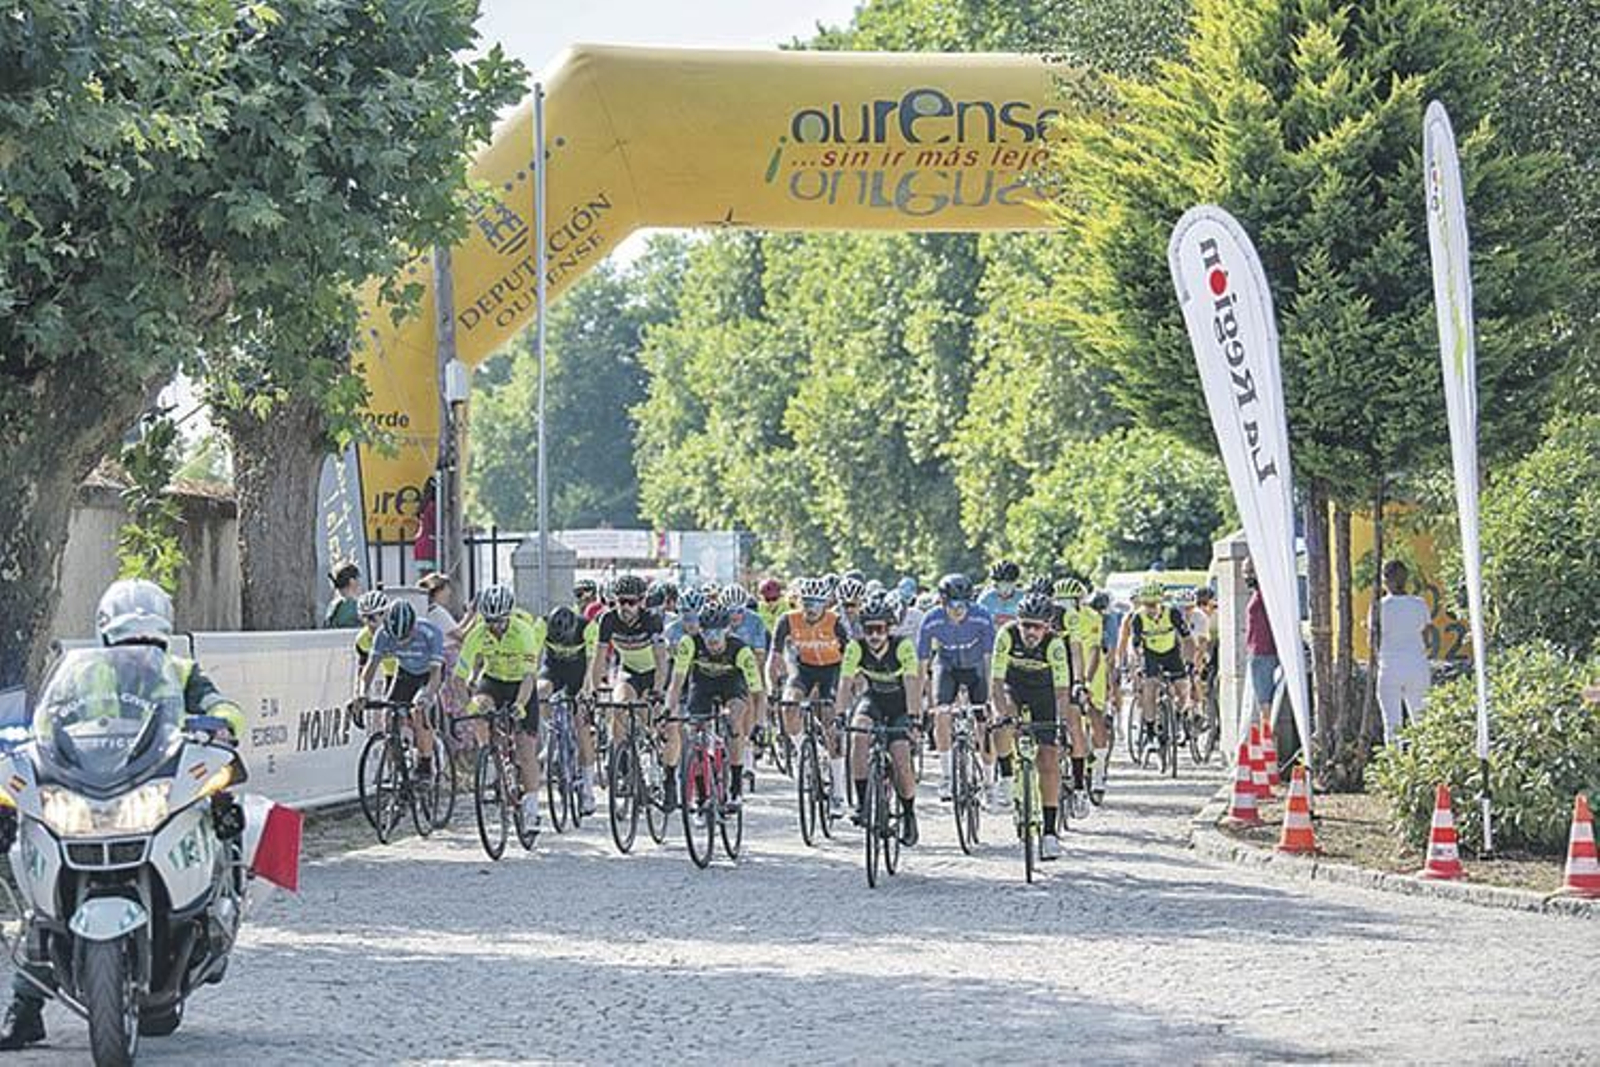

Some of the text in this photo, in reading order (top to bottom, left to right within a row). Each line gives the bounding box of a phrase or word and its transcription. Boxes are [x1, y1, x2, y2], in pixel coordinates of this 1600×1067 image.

[881, 147, 905, 167] ir
[915, 146, 978, 168] más
[458, 192, 612, 331] DEPUTCIÓN
[496, 230, 605, 328] OUENSE
